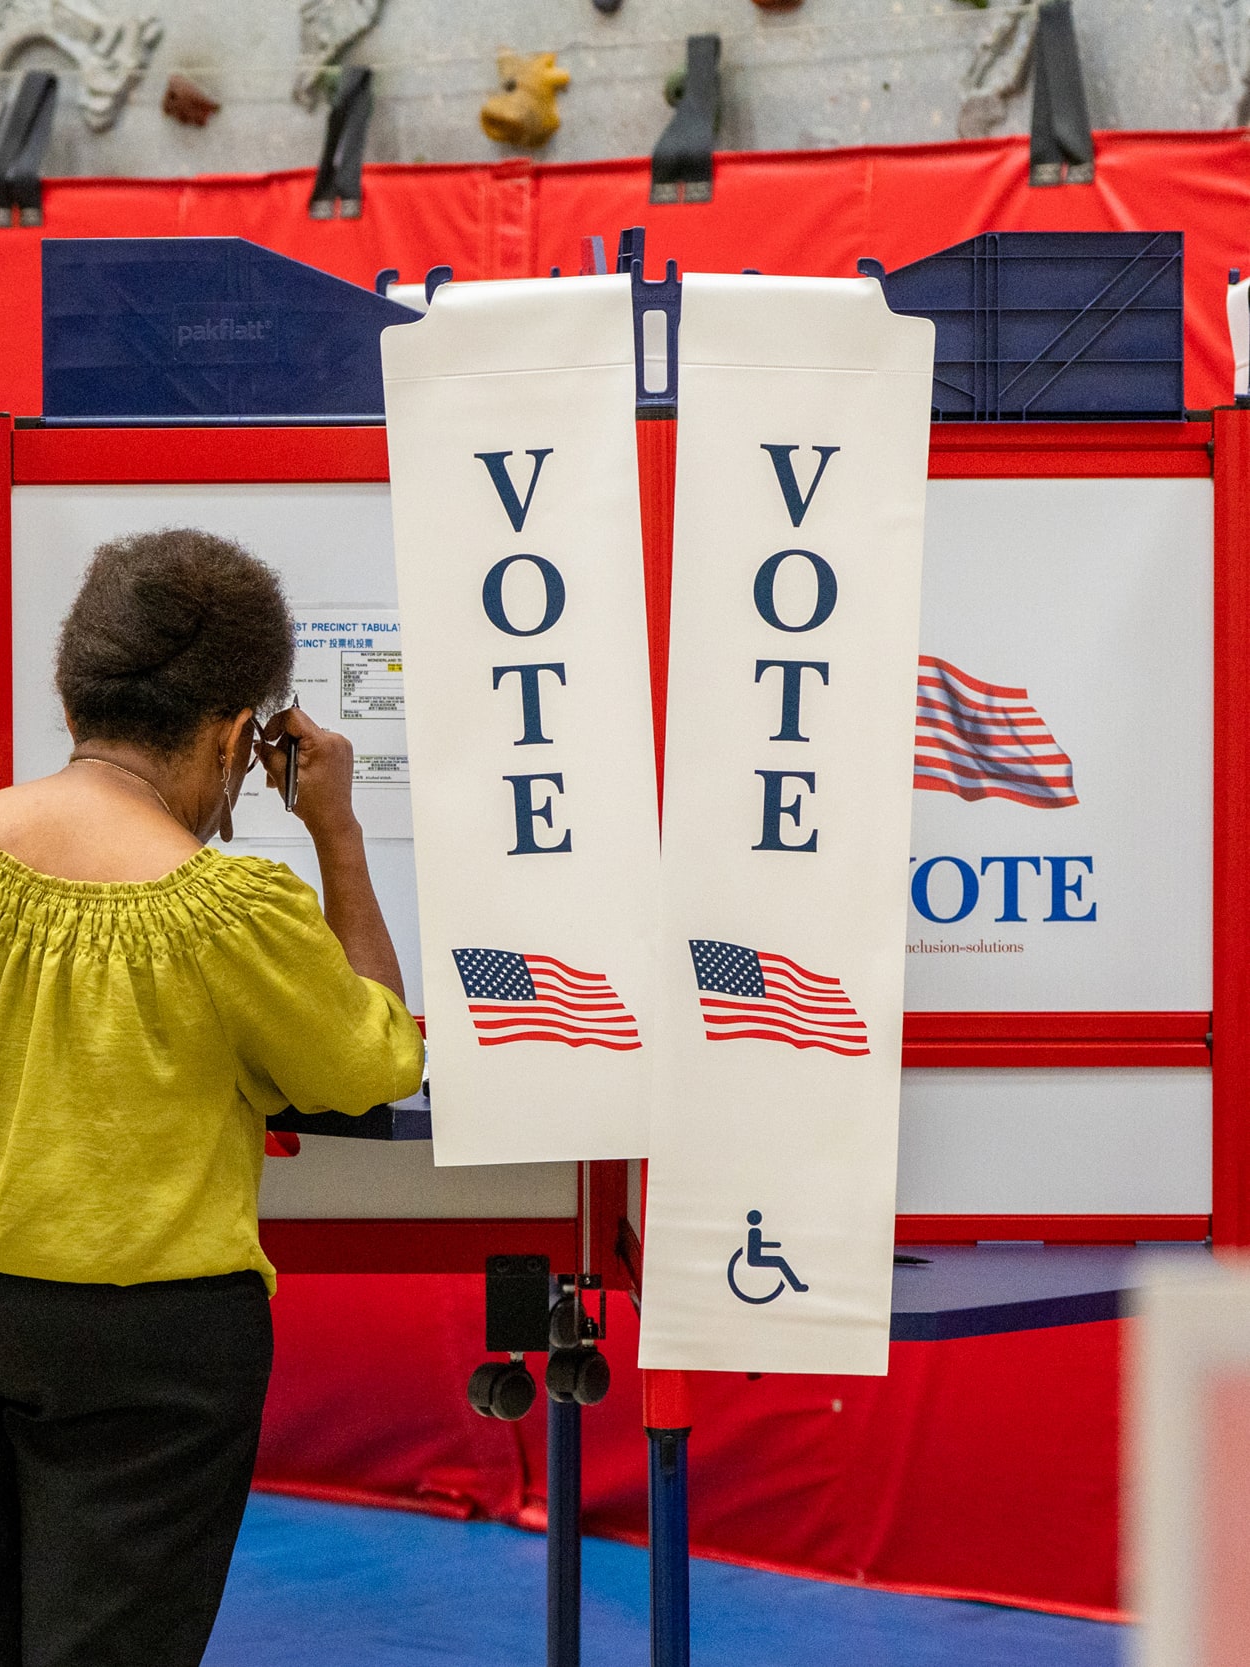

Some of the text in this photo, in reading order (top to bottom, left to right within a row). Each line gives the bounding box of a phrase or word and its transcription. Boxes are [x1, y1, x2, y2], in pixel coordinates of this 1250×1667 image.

[473, 447, 572, 856] VOTE
[751, 443, 841, 853] VOTE
[905, 939, 1024, 953] nclusion-solutions
[910, 855, 1098, 924] OTE
